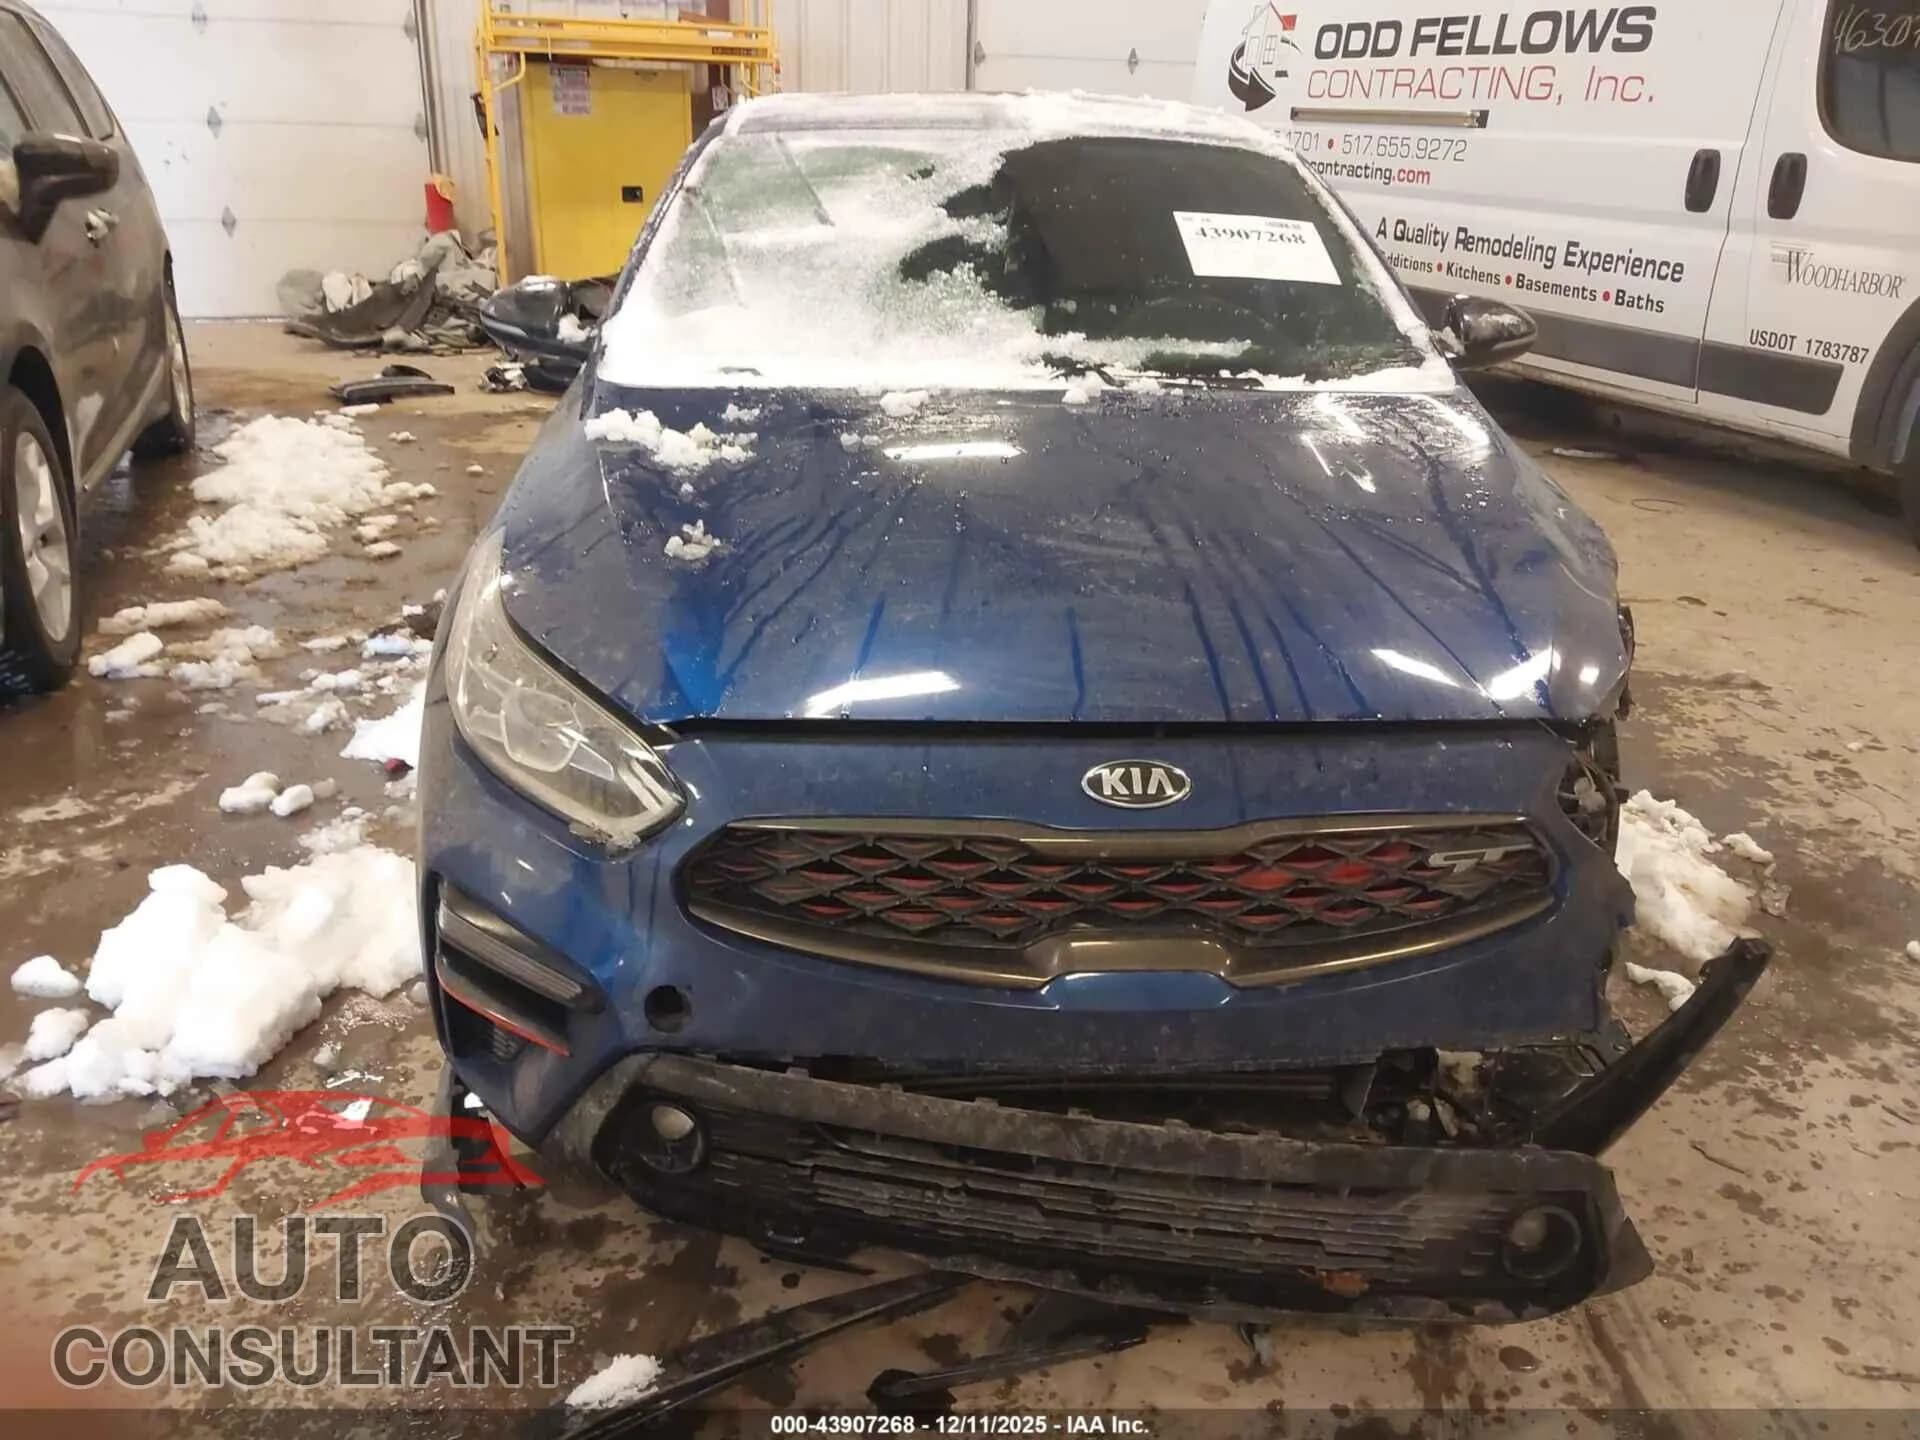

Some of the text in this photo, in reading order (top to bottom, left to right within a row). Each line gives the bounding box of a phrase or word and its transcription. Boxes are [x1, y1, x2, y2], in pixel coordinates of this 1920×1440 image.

[1314, 6, 1657, 60] ODD FELLOWS
[1307, 65, 1653, 105] CONTRACTING, Inc.
[1342, 133, 1468, 163] 517.655.9272
[1376, 216, 1685, 283] A Quality Remodeling Experience
[1386, 251, 1665, 314] dditions Kitchens Basements Baths
[1750, 328, 1870, 364] USDOT 1783787
[1094, 767, 1180, 796] KIA
